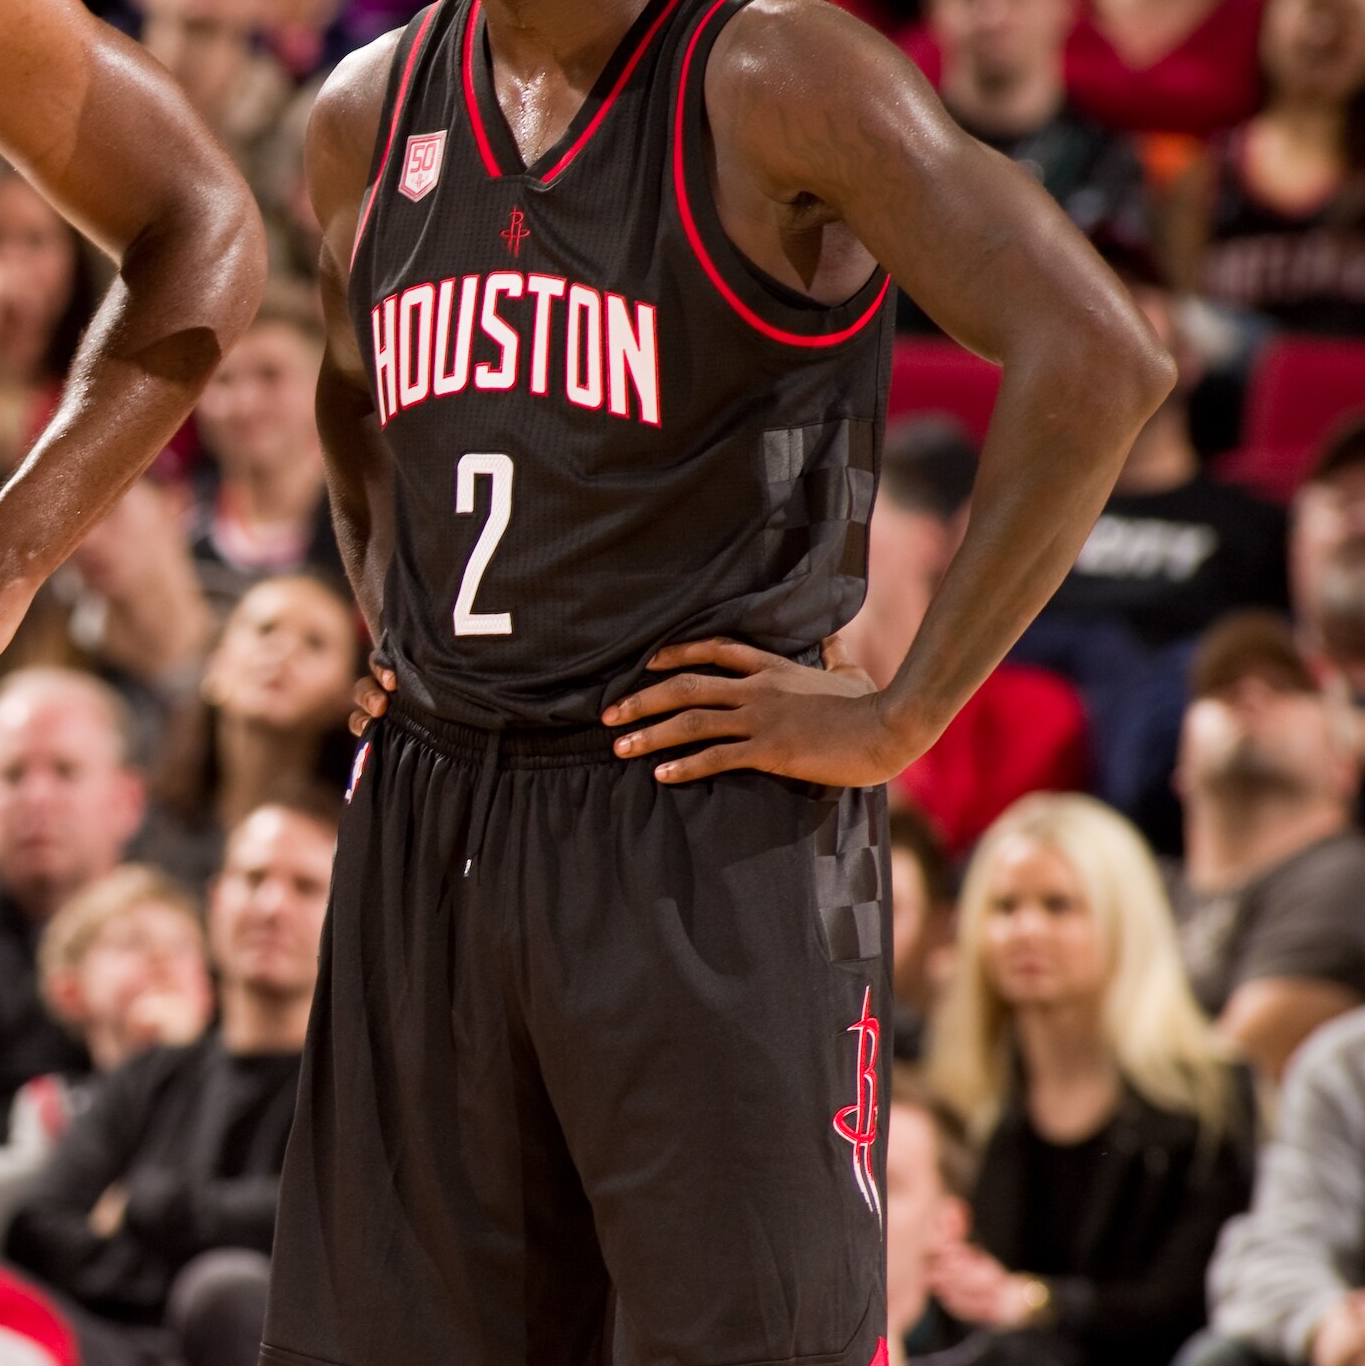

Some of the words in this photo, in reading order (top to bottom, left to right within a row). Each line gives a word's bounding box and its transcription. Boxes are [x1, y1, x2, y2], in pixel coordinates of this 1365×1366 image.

[410, 142, 437, 173] 50
[371, 268, 661, 428] HOUSTON
[453, 453, 514, 636] 2
